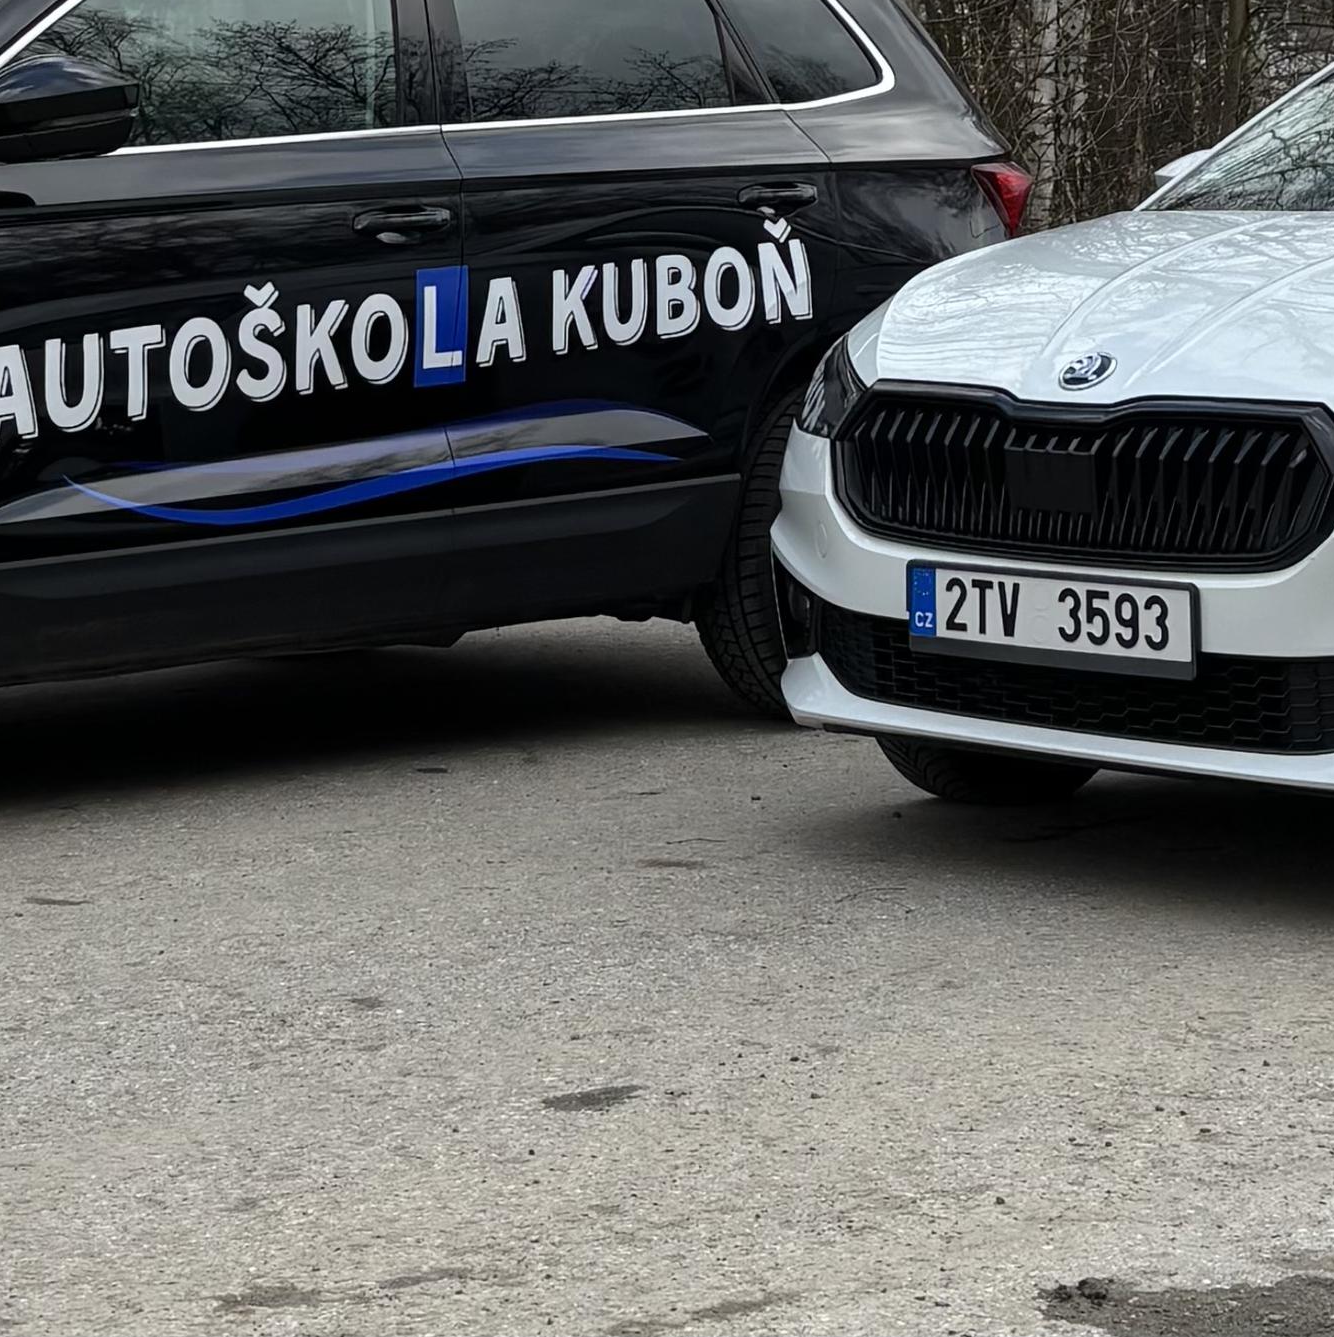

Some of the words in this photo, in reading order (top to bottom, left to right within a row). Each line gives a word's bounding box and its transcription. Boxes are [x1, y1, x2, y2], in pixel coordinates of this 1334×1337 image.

[552, 217, 812, 355] KUBOŇ
[914, 611, 933, 628] CZ
[945, 577, 1020, 637] 2TV
[1058, 588, 1169, 651] 3593
